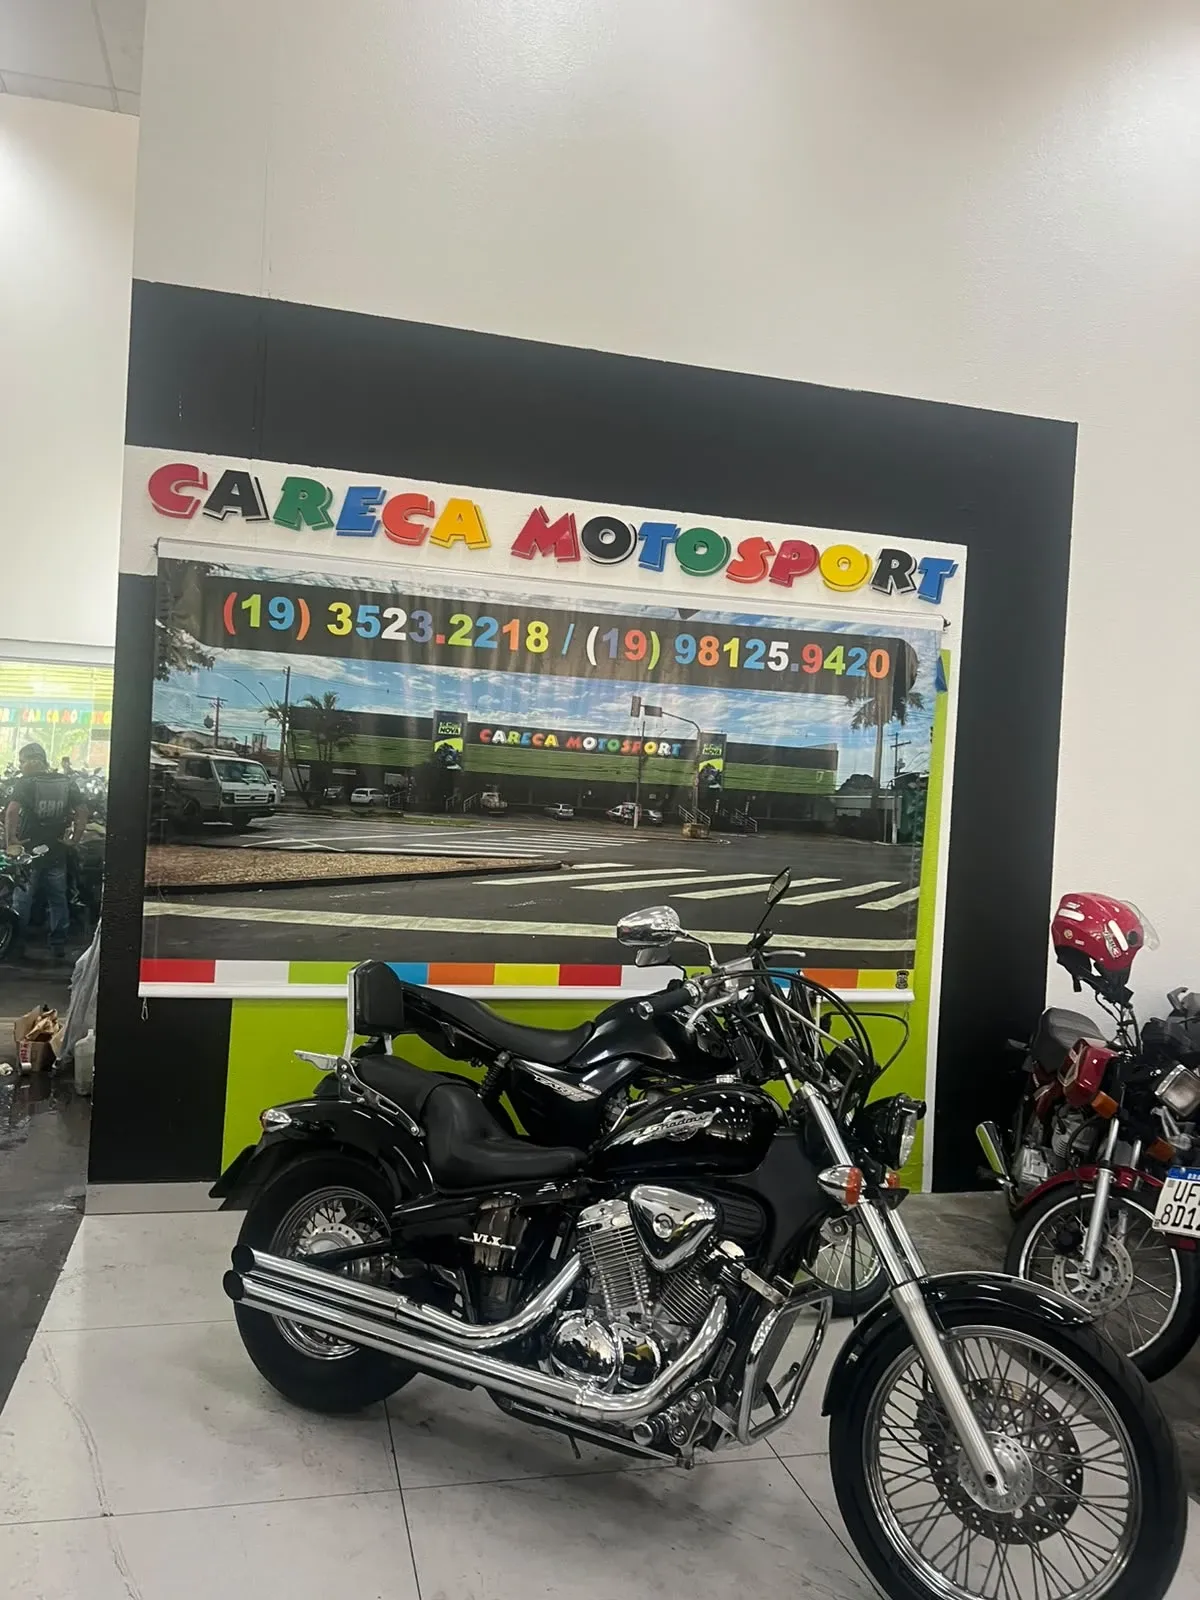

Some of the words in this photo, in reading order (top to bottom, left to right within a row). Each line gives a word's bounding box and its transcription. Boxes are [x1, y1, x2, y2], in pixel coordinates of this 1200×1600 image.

[147, 462, 491, 550] CARECA
[510, 505, 958, 604] MOTOSPORT
[223, 592, 311, 641] (19)
[327, 601, 549, 654] 3523.2218
[586, 625, 661, 671] (19)
[674, 633, 890, 679] 98125.9420
[479, 728, 559, 748] CARECA
[566, 735, 682, 758] MOTOSPORT
[1173, 1181, 1200, 1206] UF
[473, 1232, 502, 1247] VLX
